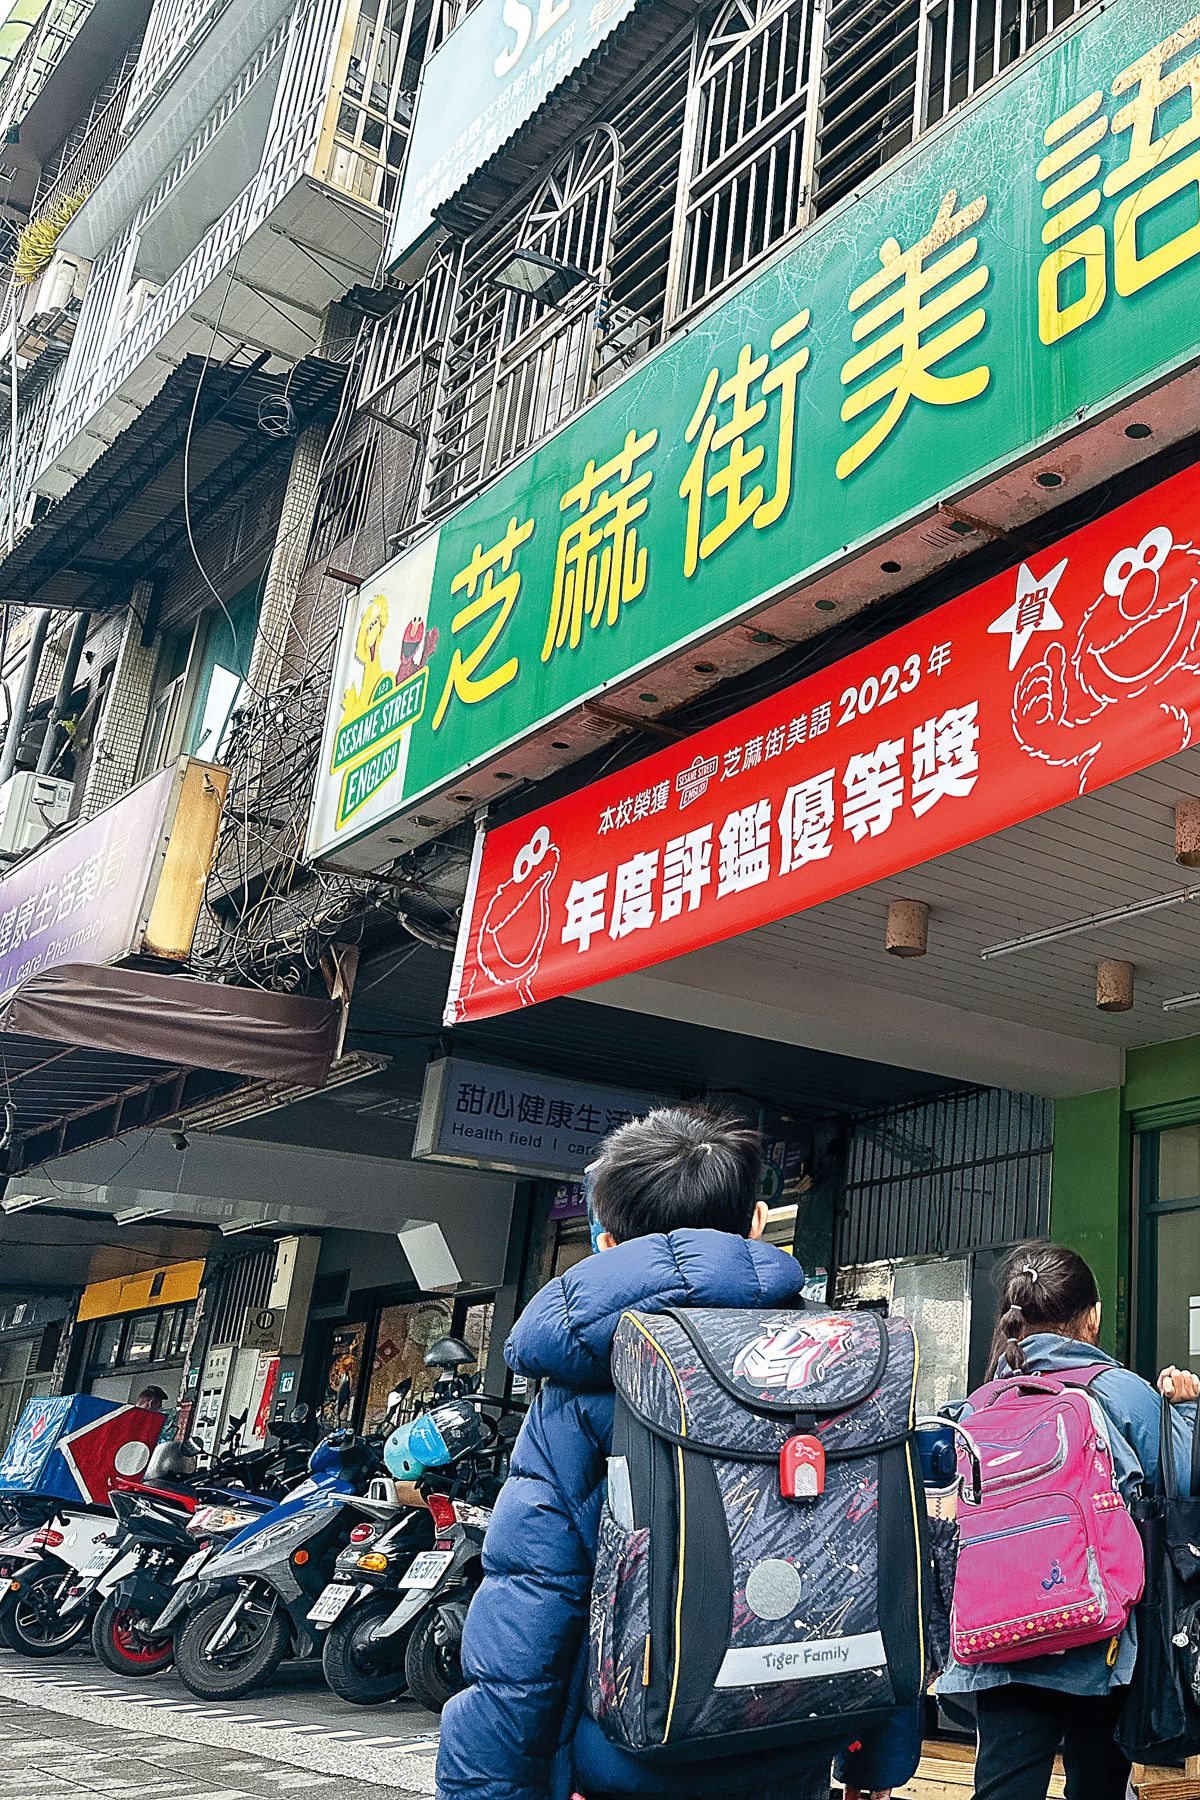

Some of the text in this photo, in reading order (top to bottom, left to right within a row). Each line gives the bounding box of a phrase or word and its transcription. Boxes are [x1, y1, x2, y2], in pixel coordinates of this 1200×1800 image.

[1016, 586, 1049, 635] 賀
[337, 679, 423, 762] SESAME STREET
[597, 779, 671, 836] 本校榮獲
[836, 653, 921, 728] 2023
[926, 640, 952, 678] 年
[344, 743, 398, 815] ENGLISH
[561, 700, 981, 954] 年度評鑑優等獎
[15, 951, 43, 983] care
[43, 914, 109, 966] Pharmacy
[452, 1122, 504, 1142] Health
[509, 1131, 543, 1149] field
[762, 1646, 849, 1670] Tiger Family
